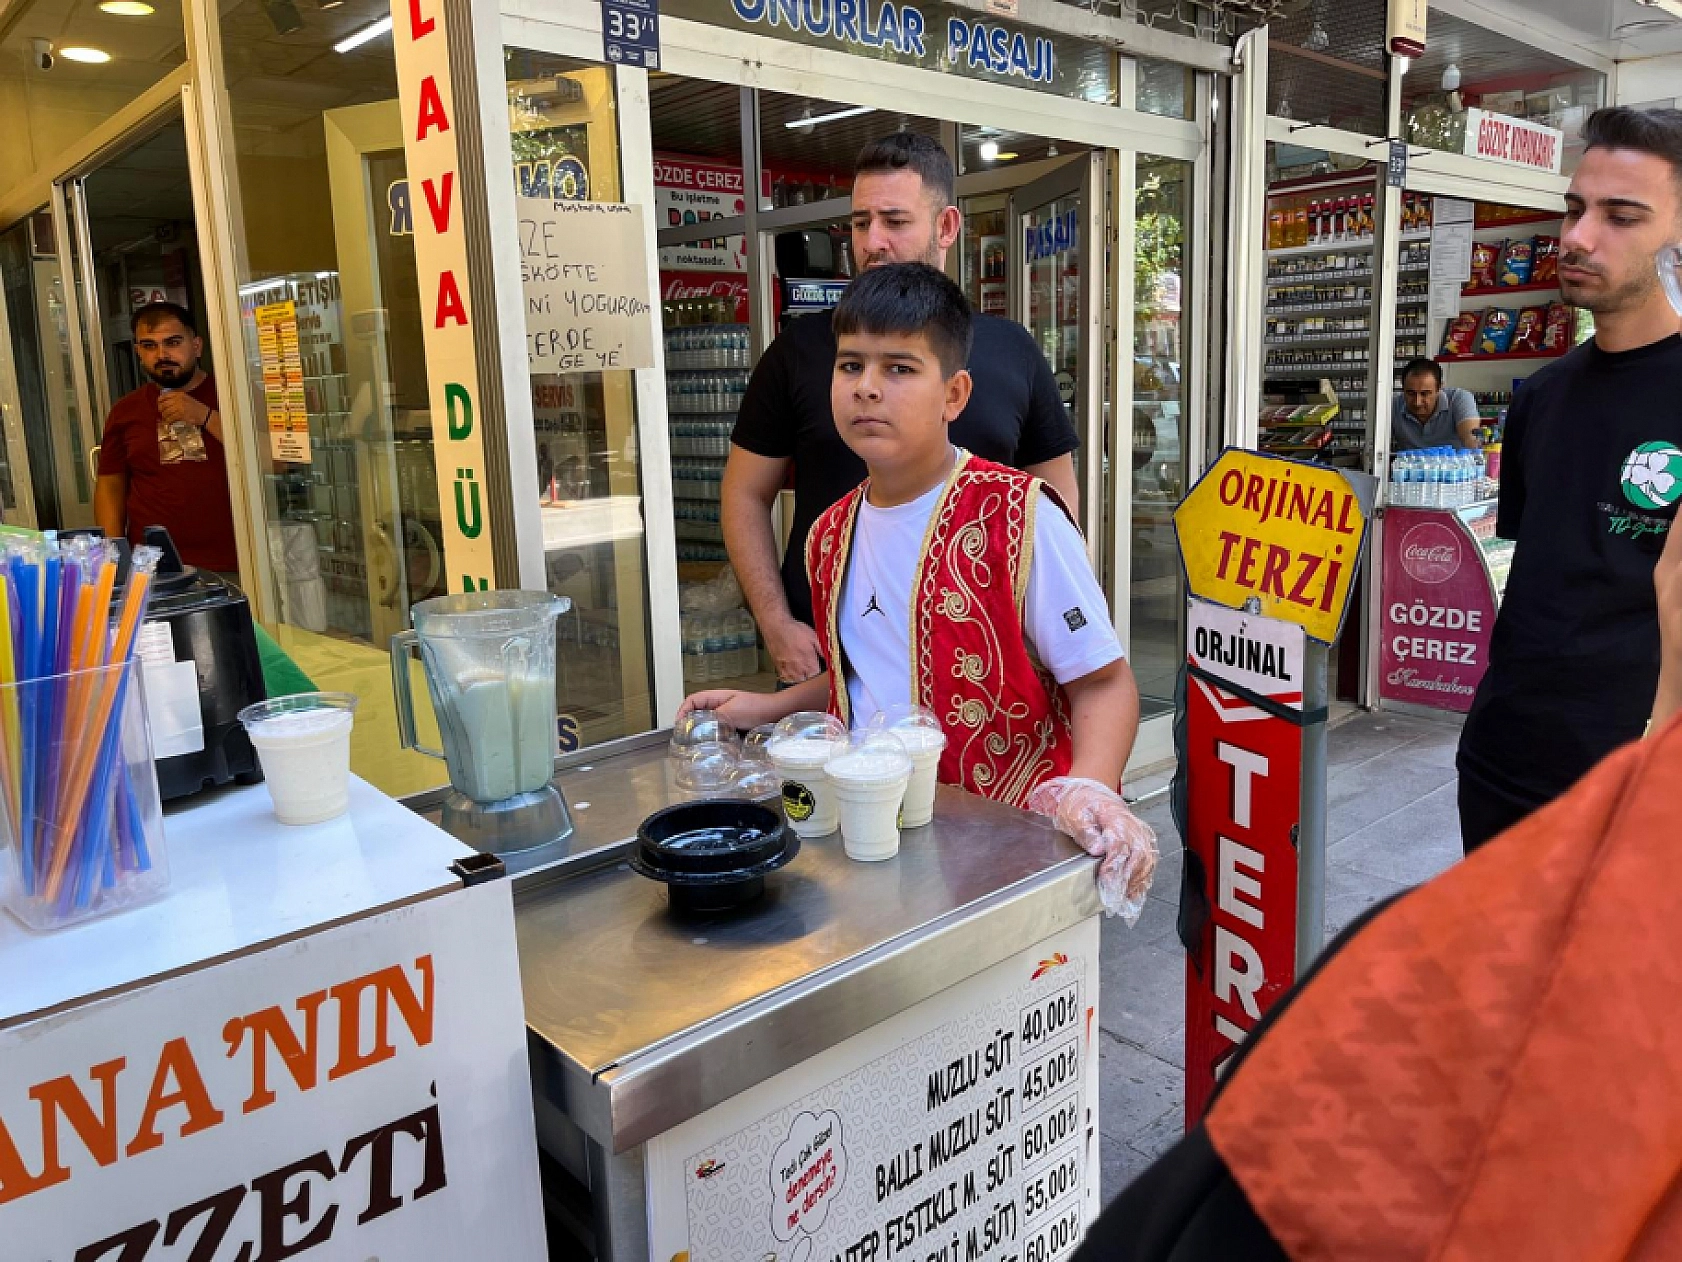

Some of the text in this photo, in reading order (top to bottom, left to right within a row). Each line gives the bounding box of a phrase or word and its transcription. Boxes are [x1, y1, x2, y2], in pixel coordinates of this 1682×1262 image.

[948, 17, 1053, 83] PASAJI
[696, 169, 743, 190] ÇEREZ
[526, 327, 595, 356] ERDE
[1219, 468, 1355, 534] ORJİNAL
[1216, 530, 1343, 613] TERZİ
[1389, 599, 1482, 632] GÖZDE
[1195, 626, 1291, 681] ORJİNAL
[1392, 635, 1477, 665] ÇEREZ
[927, 1050, 979, 1112] MUZLU
[984, 1028, 1014, 1078] SÜT
[875, 1143, 922, 1203] BALLI
[929, 1108, 980, 1172] MUZLU
[985, 1086, 1015, 1136] SÜT
[885, 1182, 957, 1260] FISTIKLI
[963, 1170, 980, 1209] M.
[987, 1143, 1015, 1193] SÜT
